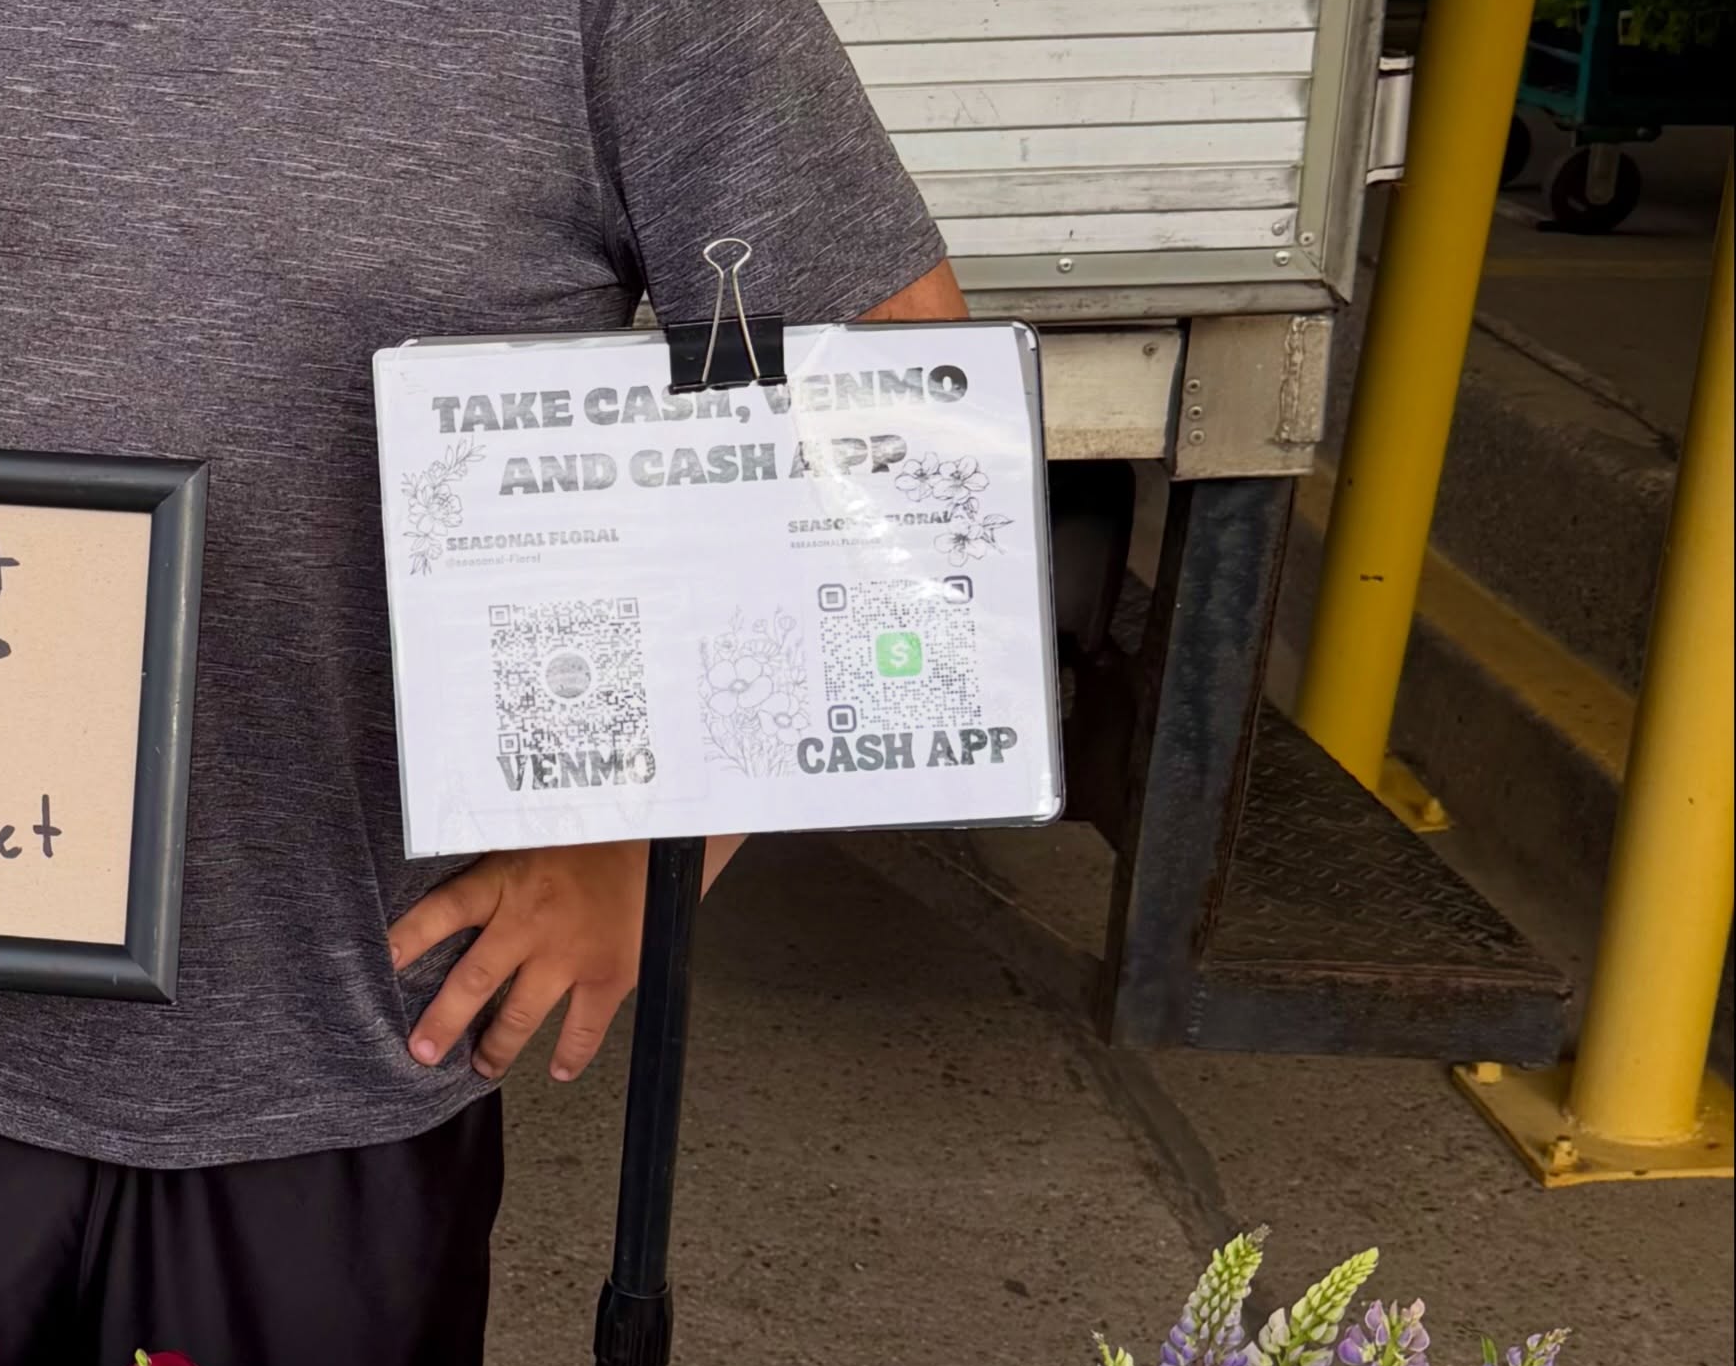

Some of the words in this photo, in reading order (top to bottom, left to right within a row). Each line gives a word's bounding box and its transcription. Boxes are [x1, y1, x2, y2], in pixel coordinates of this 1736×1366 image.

[431, 390, 574, 434] TAKE
[583, 384, 752, 425] CASH,
[764, 364, 969, 415] VENMO
[498, 452, 618, 495] AND
[629, 442, 779, 488] CASH
[789, 434, 909, 479] APP
[445, 532, 546, 552] SEASONAL
[548, 528, 620, 546] FLORAL
[495, 746, 657, 792] VENMO
[796, 731, 916, 775] CASH
[925, 726, 1019, 768] APP
